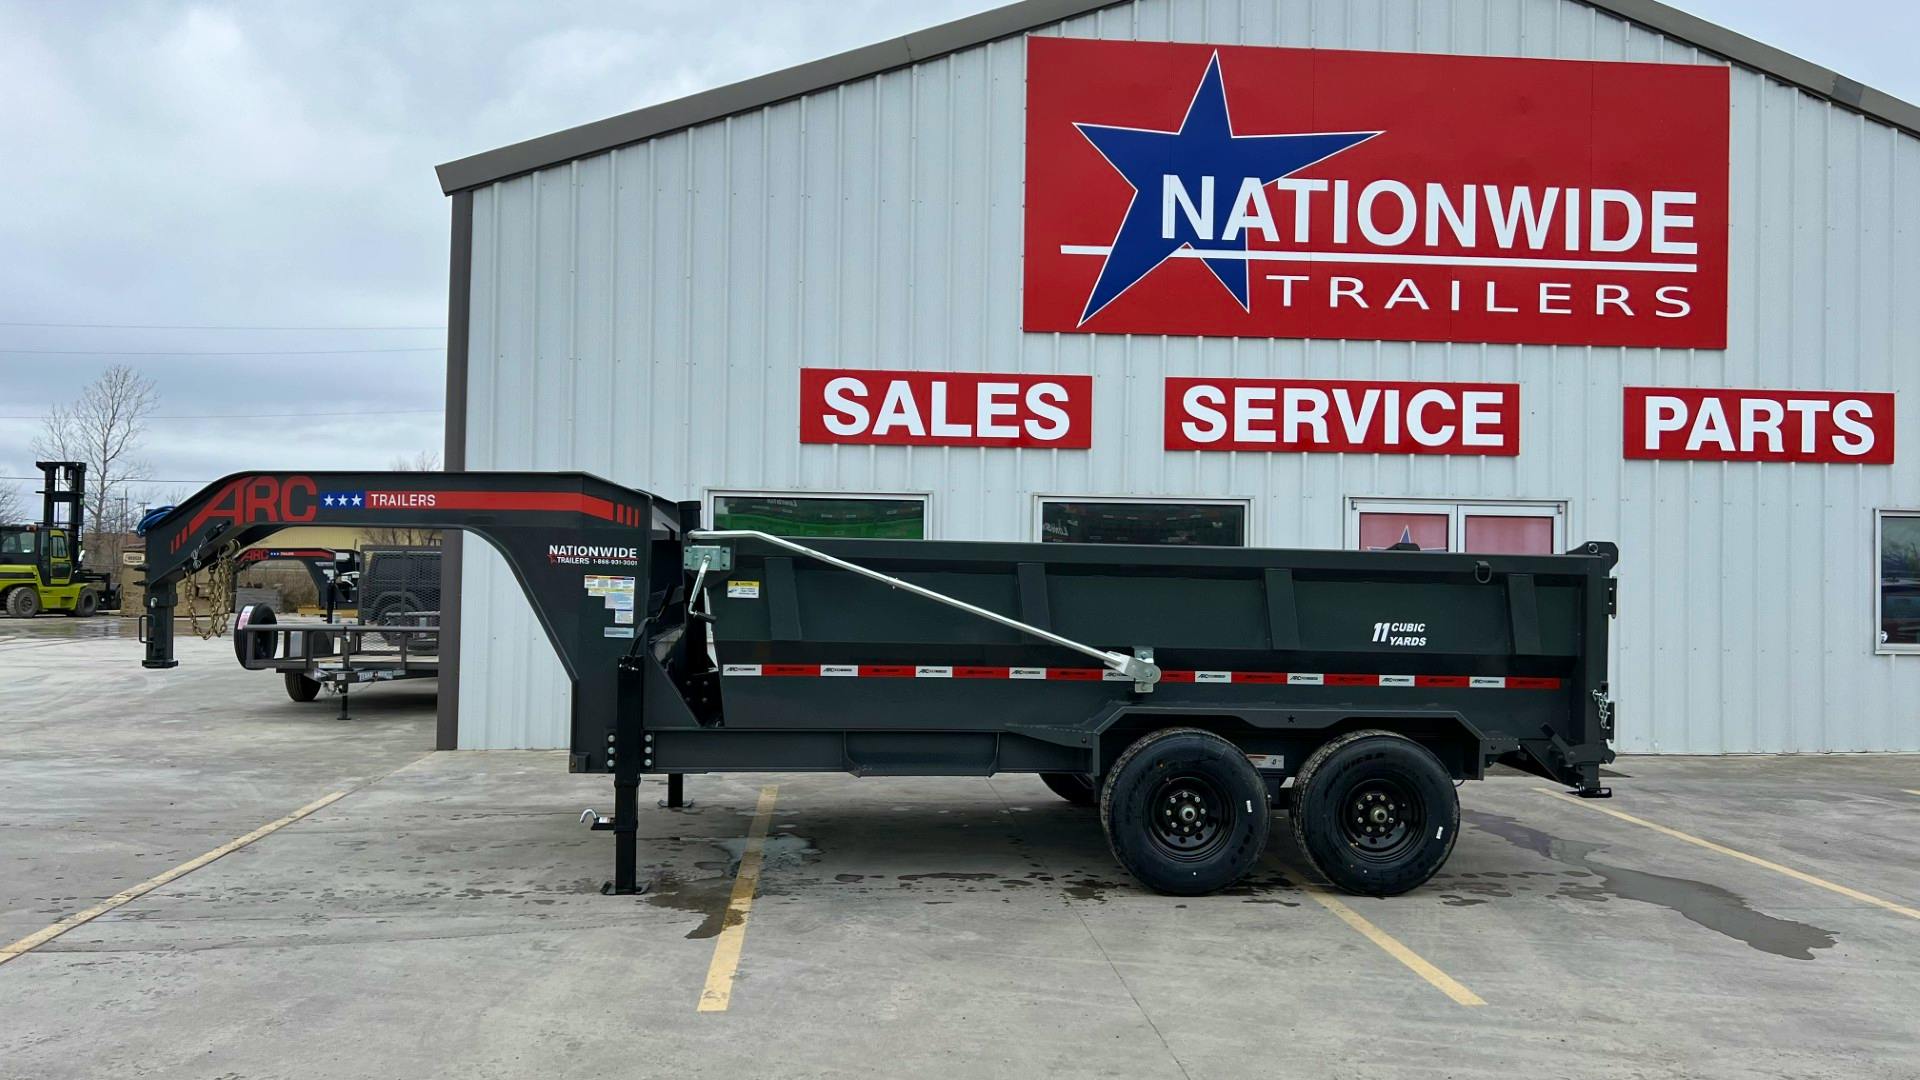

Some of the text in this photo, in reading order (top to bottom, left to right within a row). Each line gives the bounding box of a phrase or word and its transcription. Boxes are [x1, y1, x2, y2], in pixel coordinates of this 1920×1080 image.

[1162, 174, 1698, 255] NATIONWIDE
[1265, 274, 1692, 318] TRAILERS
[822, 376, 1071, 441] SALES
[1180, 384, 1505, 447] SERVICE
[1644, 395, 1876, 456] PARTS
[189, 475, 436, 534] ARC TRAILERS
[549, 544, 638, 559] NATIONWIDE
[556, 556, 590, 565] TRAILERS
[1372, 622, 1426, 642] 11 CUBIC
[1389, 636, 1427, 647] YARDS
